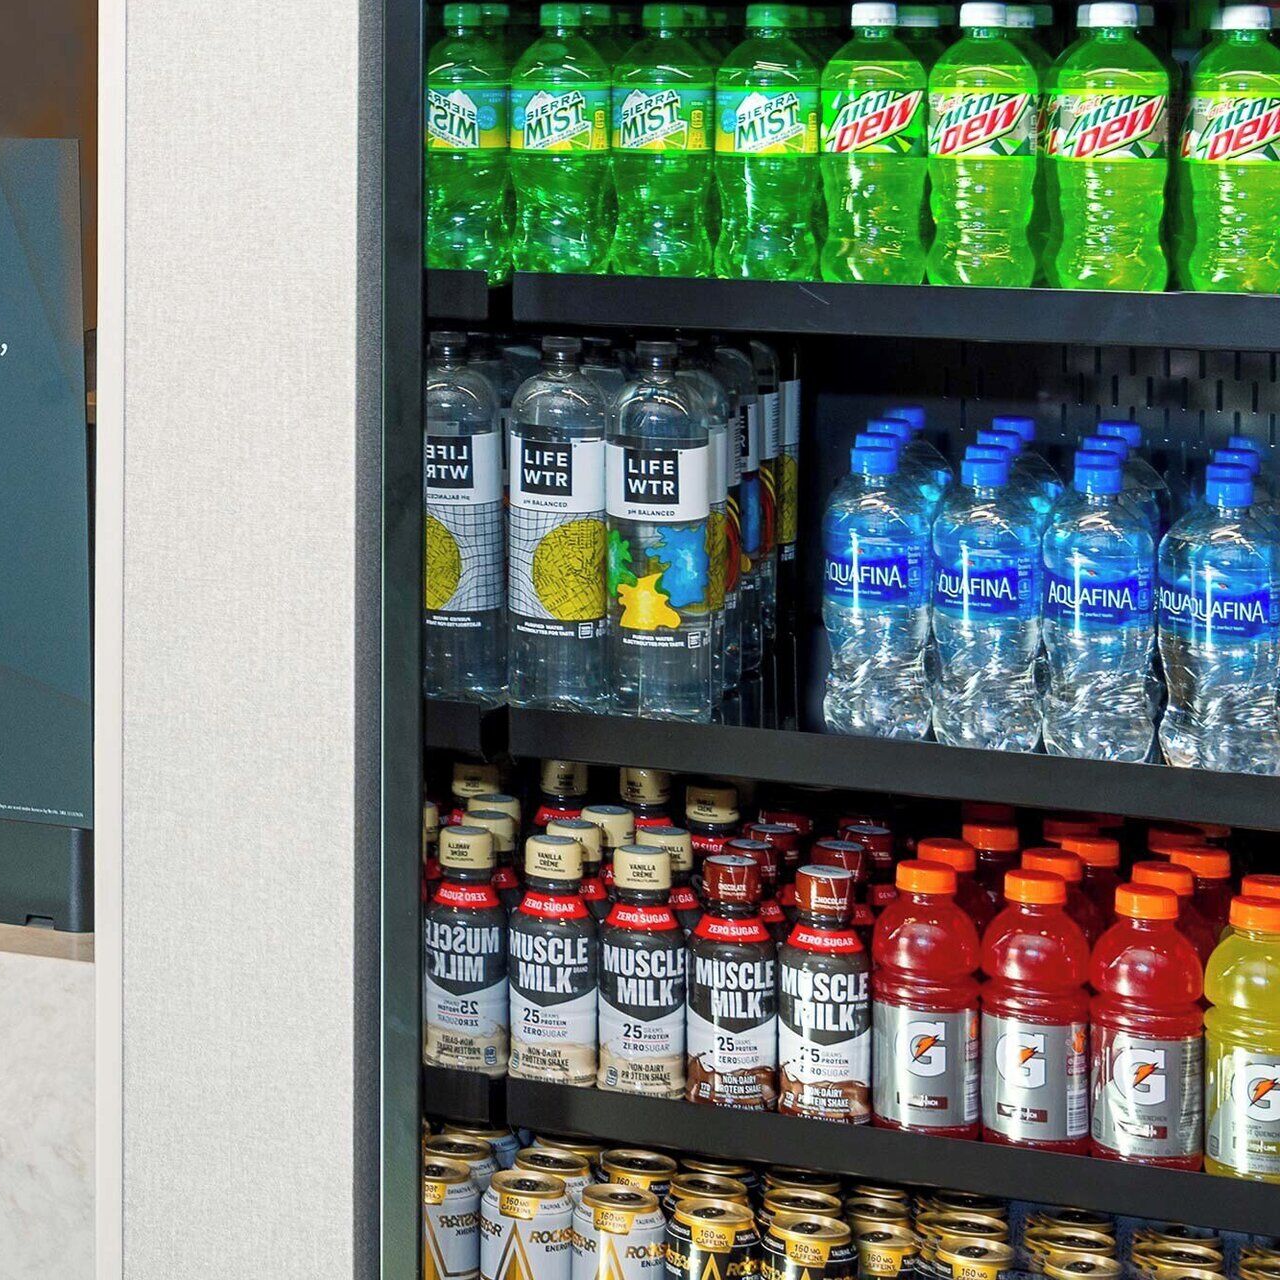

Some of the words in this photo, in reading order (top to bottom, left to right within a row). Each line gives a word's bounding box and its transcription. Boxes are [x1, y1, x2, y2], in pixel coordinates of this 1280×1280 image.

[527, 92, 581, 121] SIERRA
[623, 90, 675, 120] SIERRA
[526, 100, 584, 146] MIST
[622, 98, 679, 145] MIST
[524, 448, 568, 468] LIFE
[628, 458, 674, 476] LIFE
[524, 468, 568, 487] WTR
[628, 478, 675, 495] WTR
[1048, 580, 1133, 610] AQUAFINA
[538, 852, 562, 861] VANILLA
[524, 898, 541, 909] ZERO
[543, 900, 574, 913] SUGAR
[616, 912, 638, 922] ZERO
[640, 913, 669, 923] SUGAR
[707, 924, 729, 934] ZERO
[730, 925, 759, 936] SUGAR
[510, 929, 588, 965] MUSCLE
[603, 944, 684, 978] MUSCLE
[519, 961, 574, 993] MILK
[696, 957, 774, 991] MUSCLE
[617, 977, 675, 1007] MILK
[711, 987, 762, 1019] MILK
[523, 1008, 539, 1023] 25
[540, 1018, 567, 1026] PROTEIN
[695, 1237, 729, 1247] CAFFEINE
[700, 1230, 715, 1238] 160
